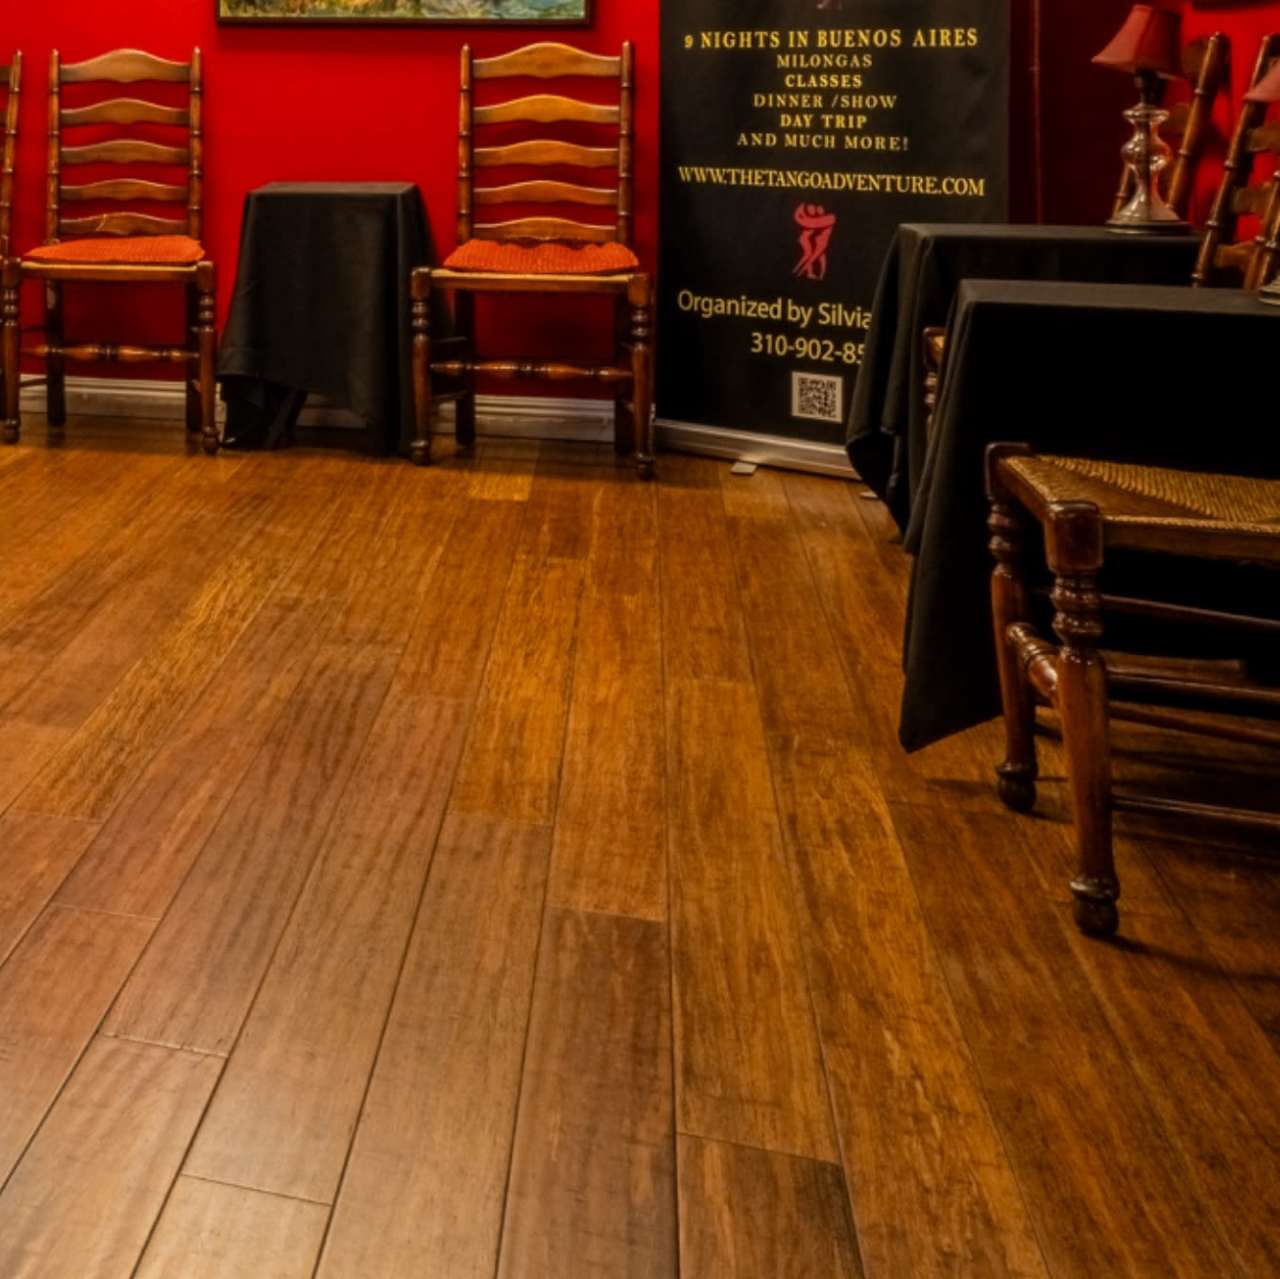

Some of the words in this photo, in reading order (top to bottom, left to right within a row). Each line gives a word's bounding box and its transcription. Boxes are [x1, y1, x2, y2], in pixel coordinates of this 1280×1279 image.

[701, 31, 780, 49] NIGHTS
[788, 31, 808, 48] IN
[817, 29, 902, 49] BUENOS
[912, 28, 978, 47] AIRES
[776, 54, 873, 68] MILONGAS
[784, 74, 863, 88] CLASSES
[753, 93, 823, 108] DINNER
[780, 114, 813, 128] DAY
[822, 115, 868, 129] TRIP
[737, 132, 777, 146] AND
[785, 133, 836, 148] MUCH
[844, 135, 909, 151] MORE!
[678, 166, 985, 196] WWW.THETANGOADVENTURE.COM
[677, 289, 782, 319] Organized
[787, 299, 813, 328] by
[818, 302, 872, 330] Silvia
